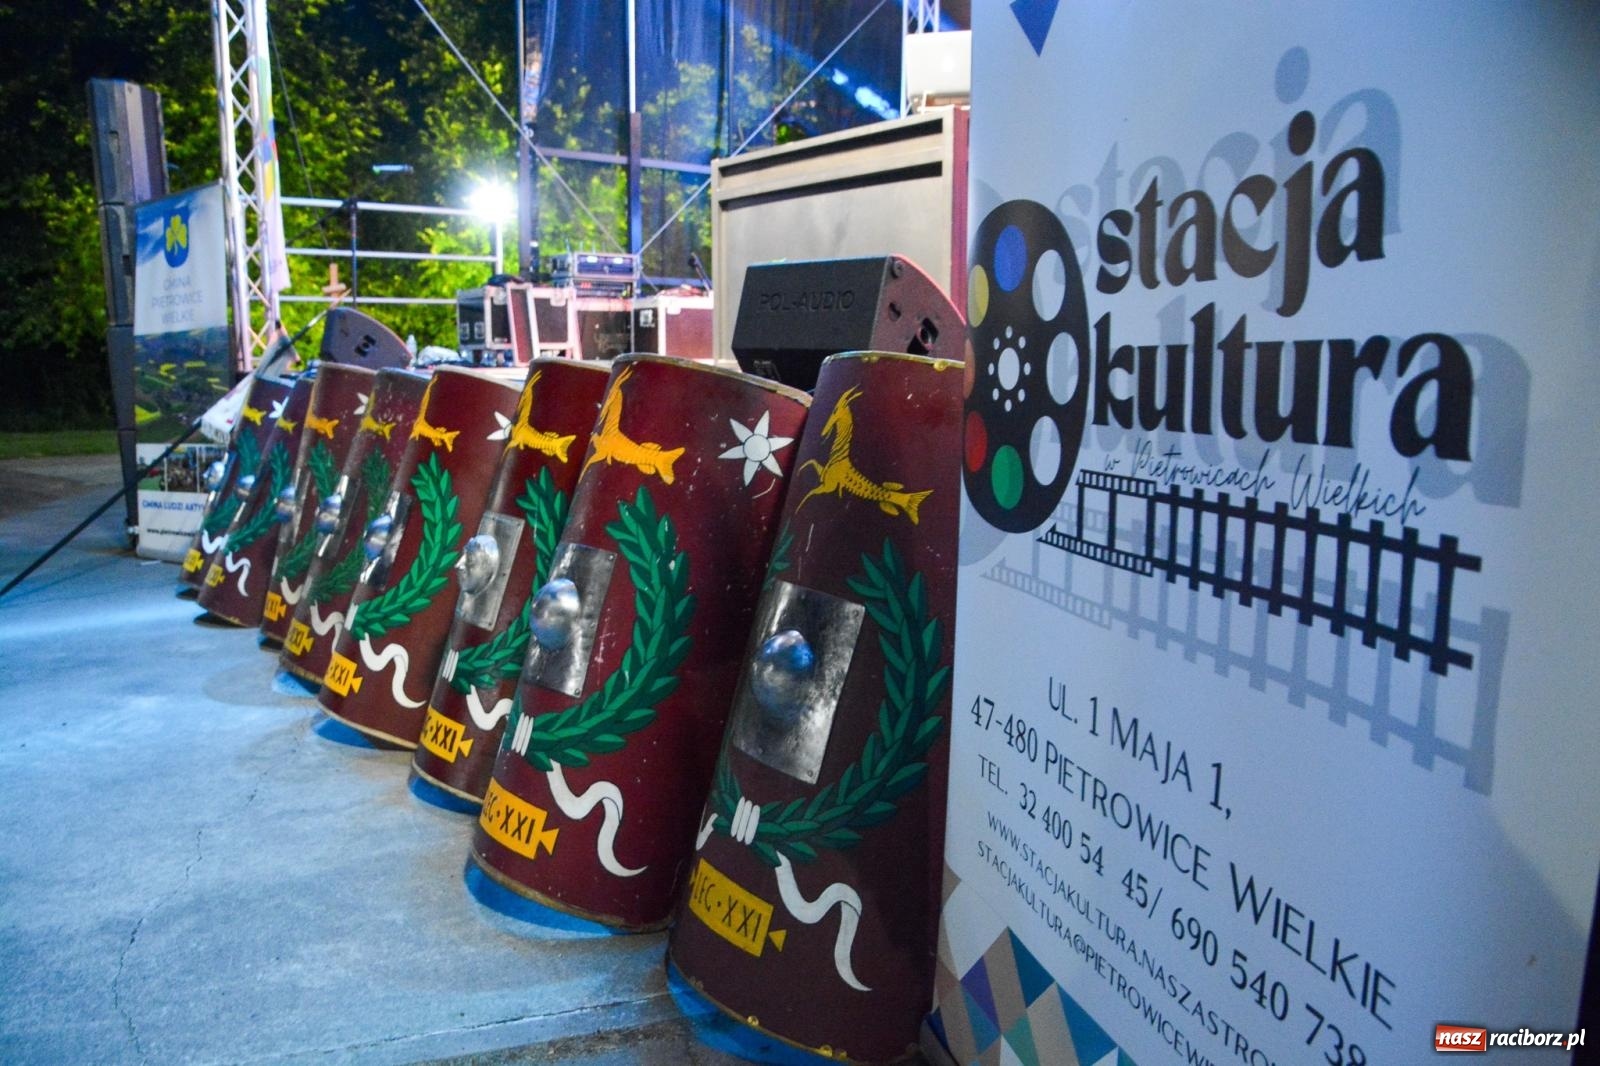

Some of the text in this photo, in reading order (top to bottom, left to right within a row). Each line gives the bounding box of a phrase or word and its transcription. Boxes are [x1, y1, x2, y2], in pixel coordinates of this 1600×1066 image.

[1096, 110, 1386, 317] stacja
[1092, 302, 1472, 462] kultura
[1104, 438, 1426, 525] w Pietrowicach Wielkich
[1049, 677, 1233, 820] UL. 1 MAJA 1,
[970, 694, 1397, 1031] 47-480 PIETROWICE WIELKIE
[978, 753, 1008, 795] TEL.
[1019, 782, 1037, 820] 32
[1042, 805, 1072, 849] 400
[1080, 832, 1105, 876] 54
[1121, 868, 1163, 919] 45/
[1171, 907, 1218, 967] 690
[1230, 949, 1289, 1021] 540
[987, 811, 1276, 1066] WWW.STACJAKULTURA.NASZASTRO
